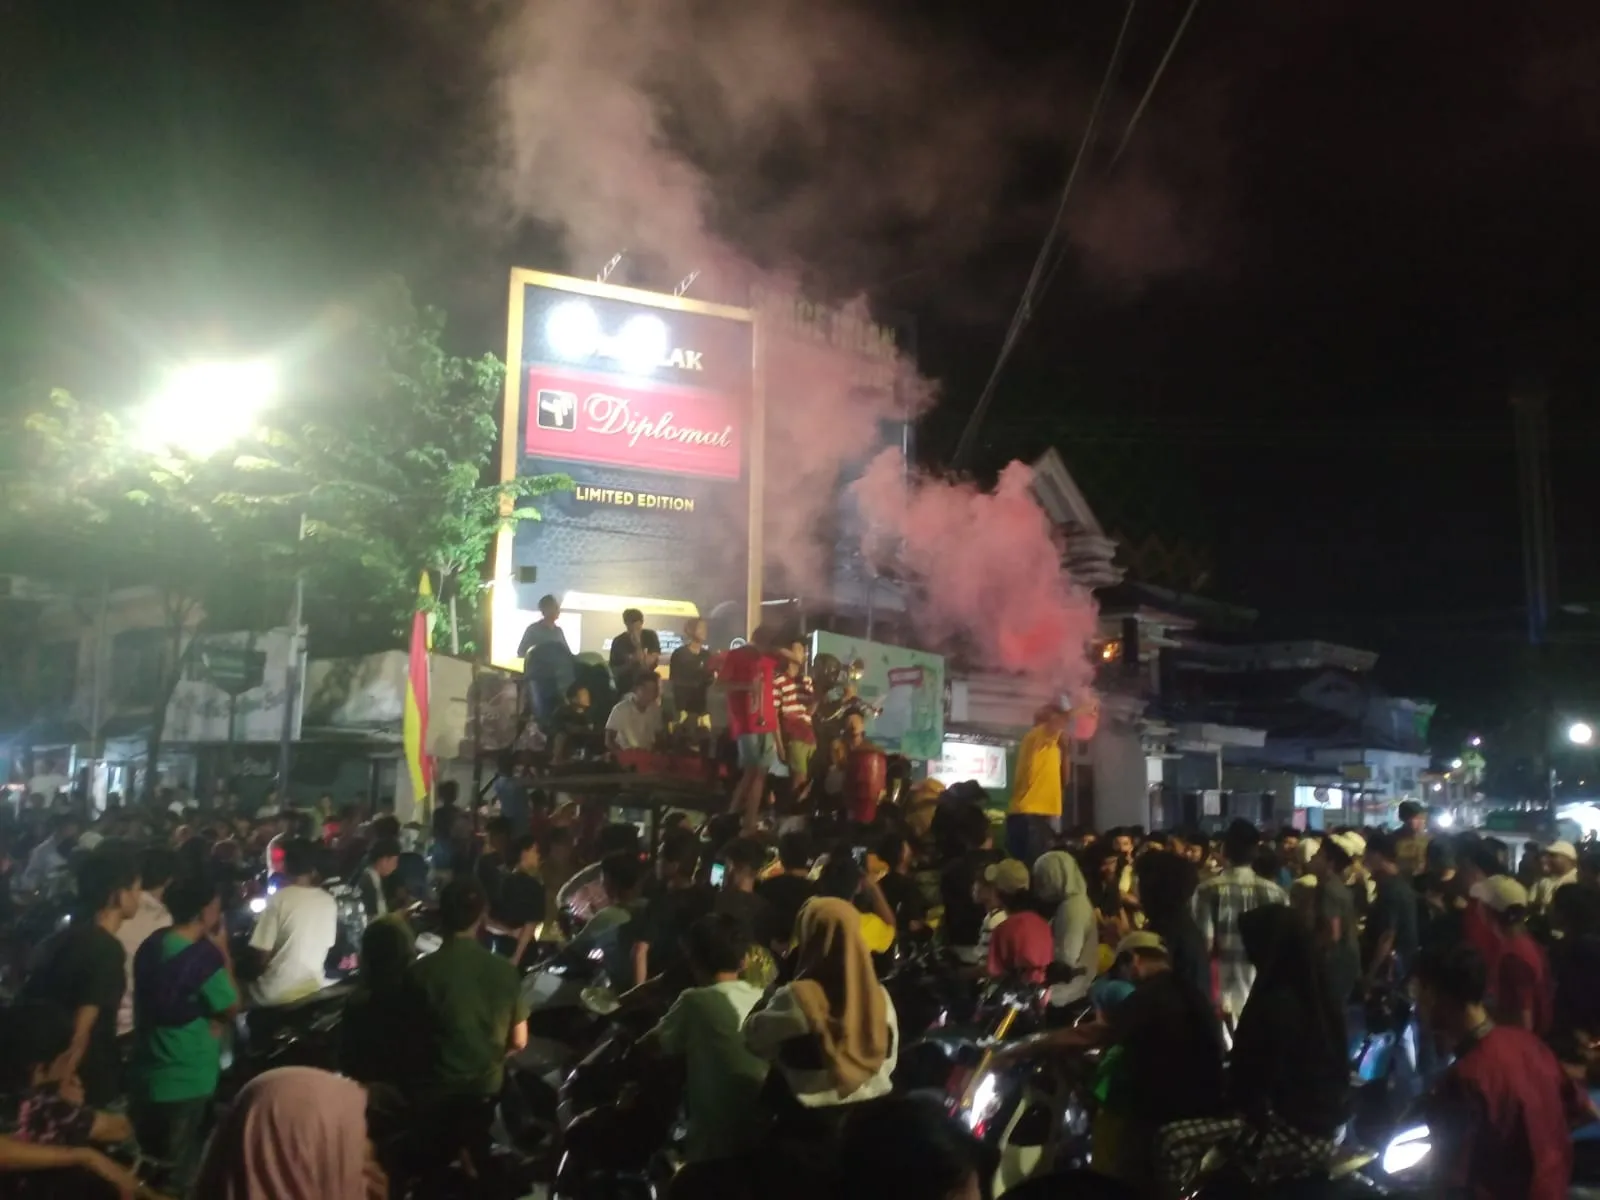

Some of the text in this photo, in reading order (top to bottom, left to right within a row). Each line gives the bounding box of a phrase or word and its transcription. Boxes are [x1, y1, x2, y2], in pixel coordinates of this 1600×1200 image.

[583, 393, 733, 447] Diplomat
[575, 486, 695, 512] LIMITED EDITION
